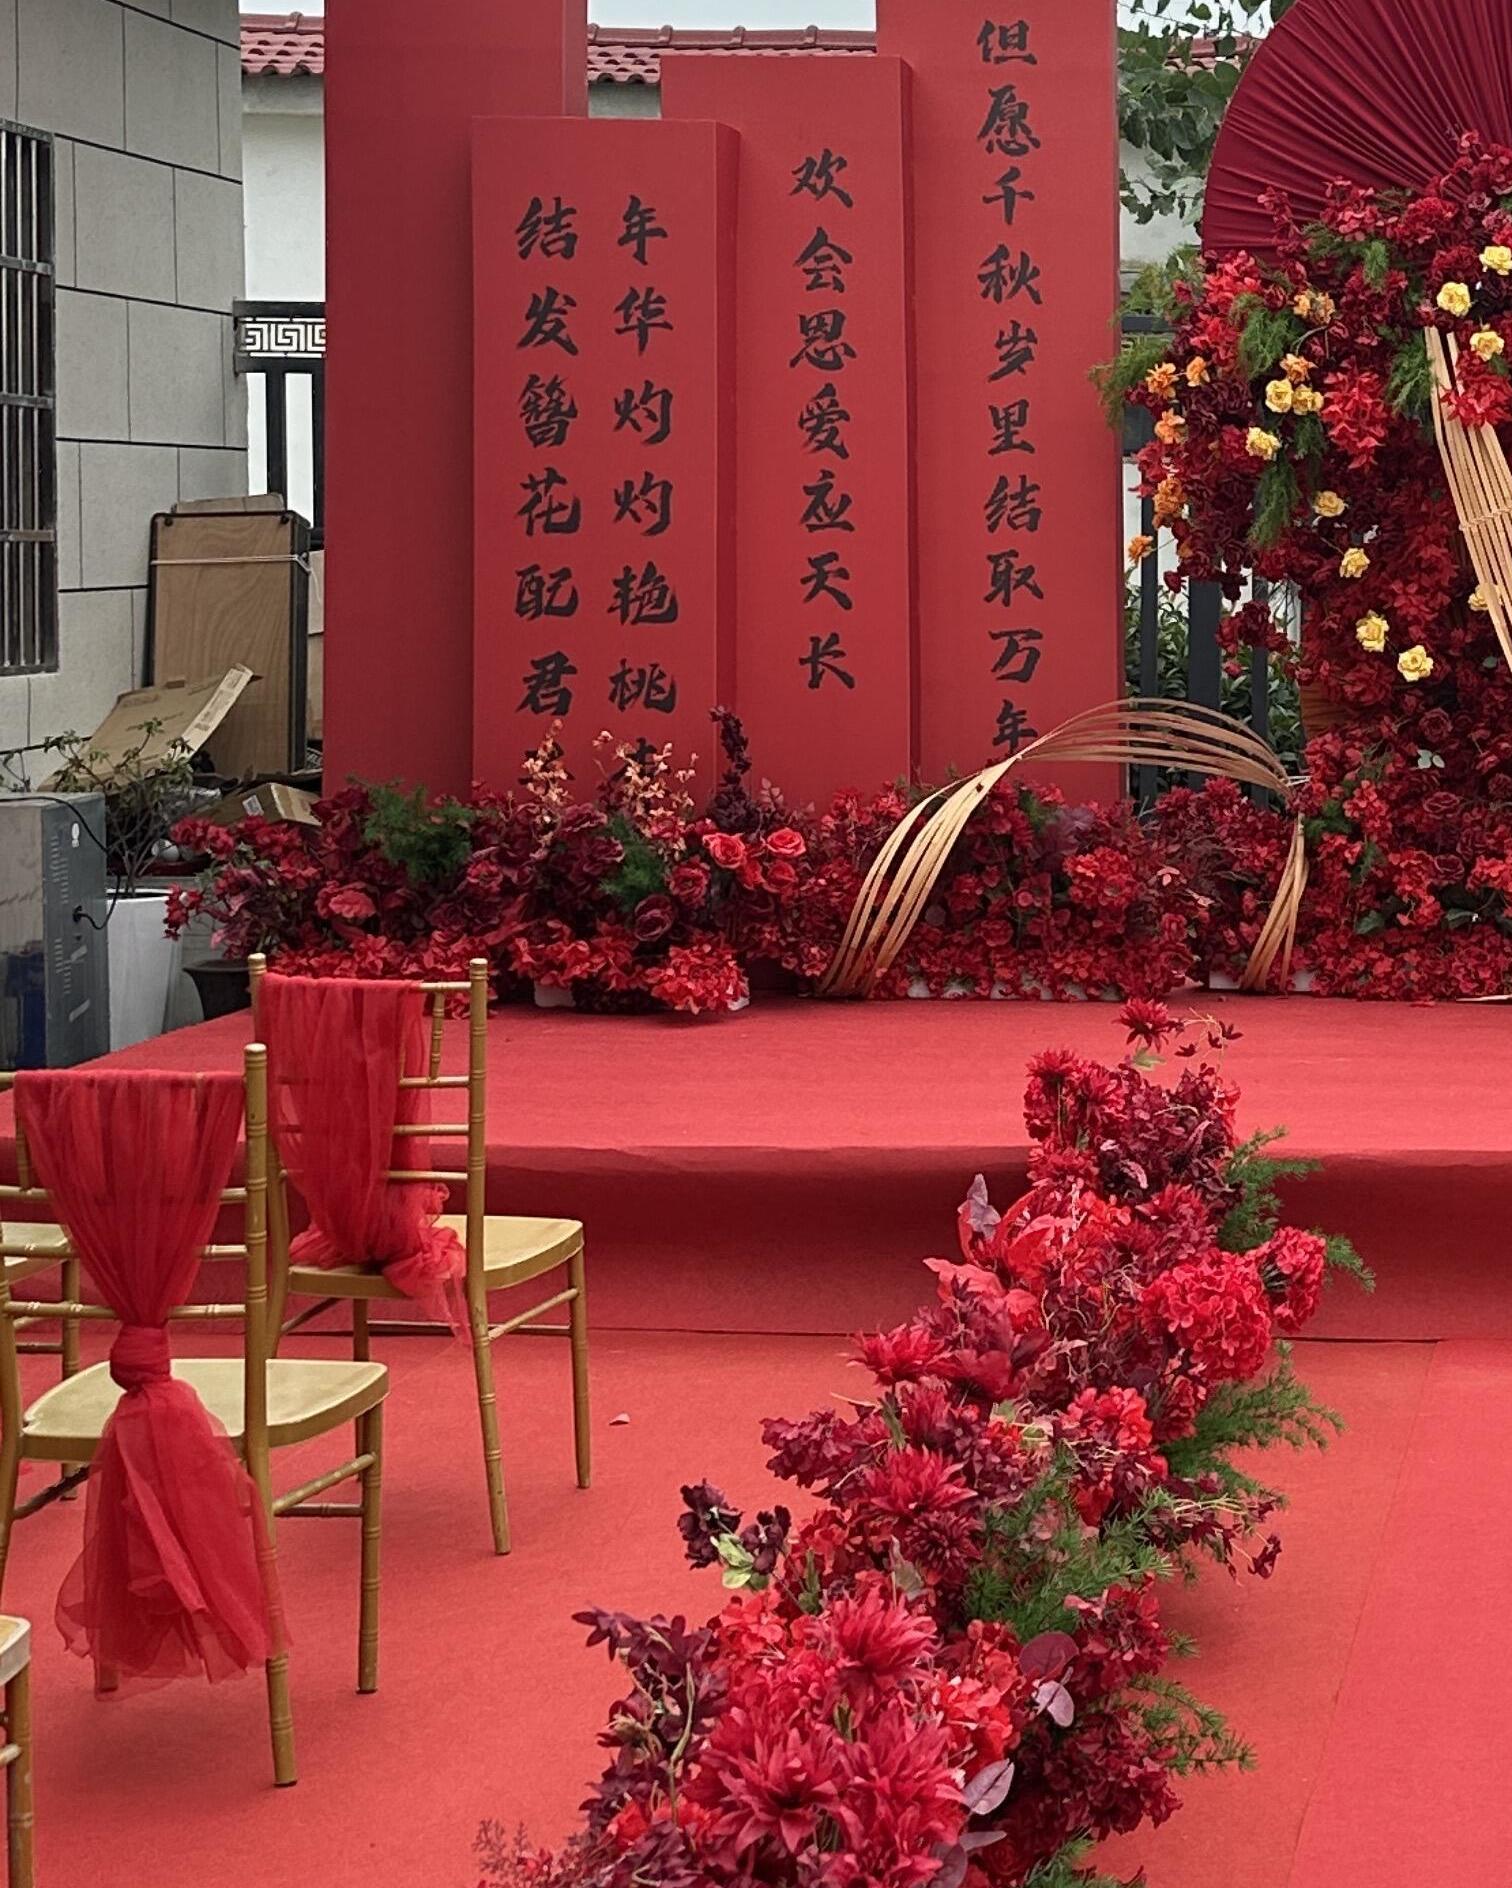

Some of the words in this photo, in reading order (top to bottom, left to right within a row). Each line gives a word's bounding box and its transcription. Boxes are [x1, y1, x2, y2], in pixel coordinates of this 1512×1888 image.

[789, 148, 856, 690] 欢会恩爱应天长
[976, 19, 1043, 756] 但愿千秋岁里结取万年
